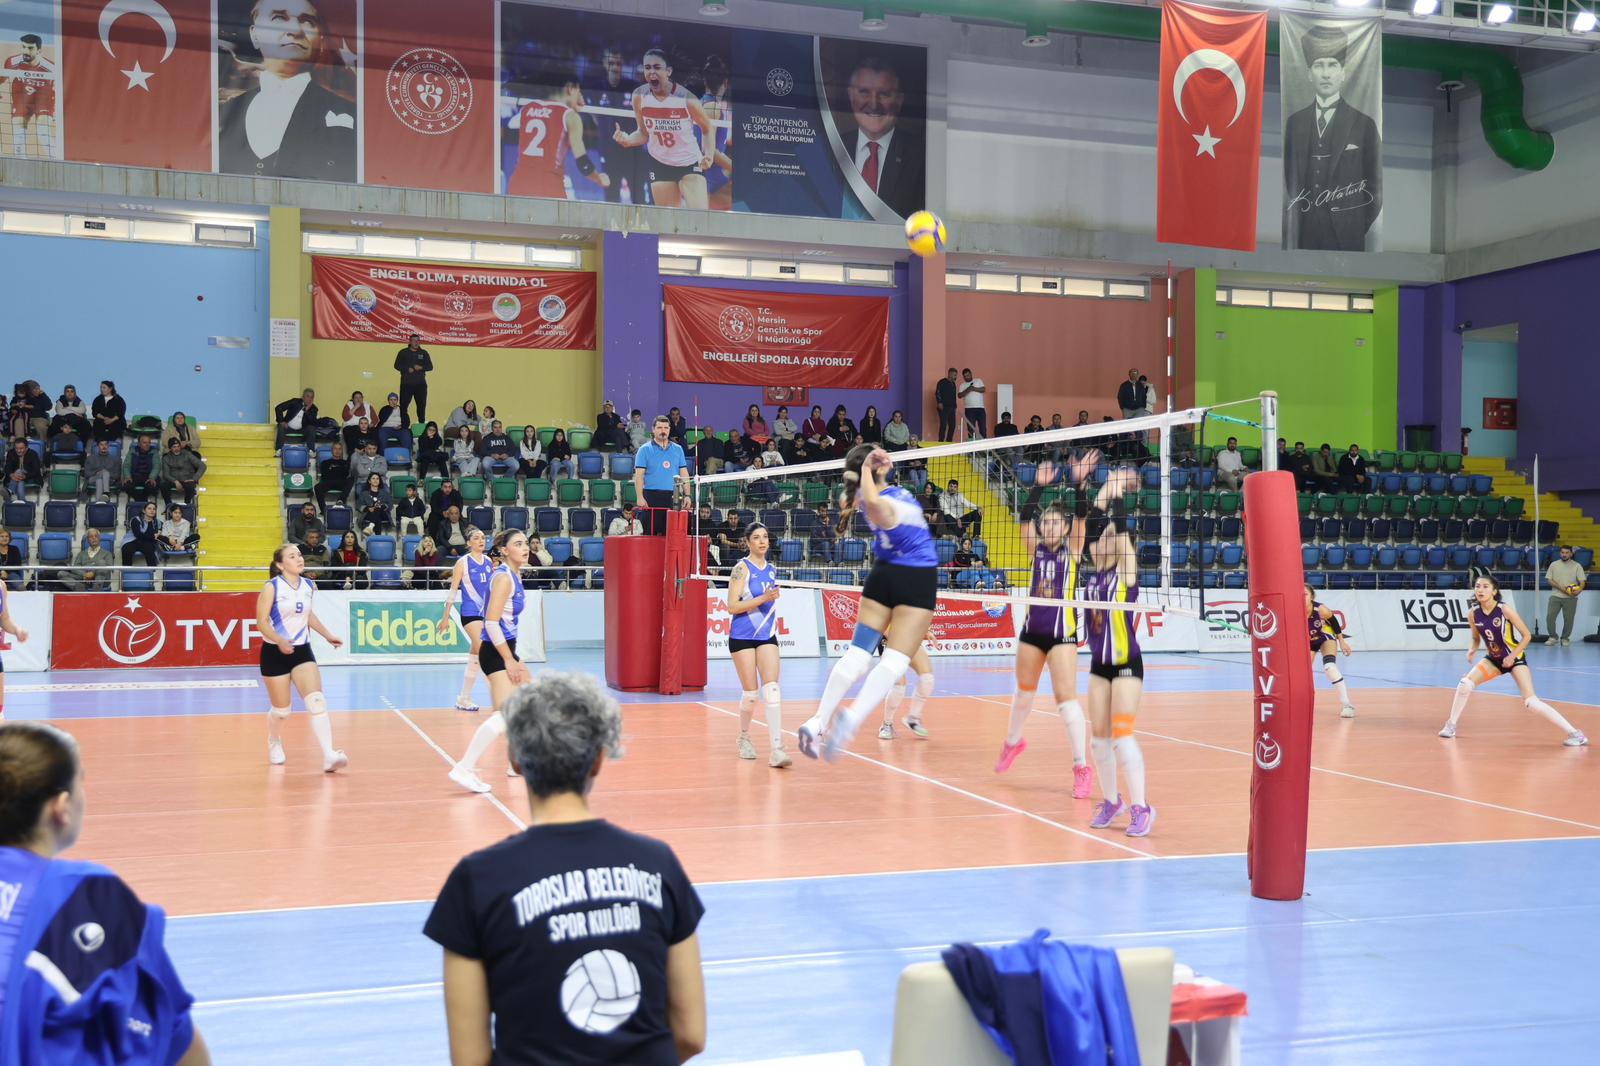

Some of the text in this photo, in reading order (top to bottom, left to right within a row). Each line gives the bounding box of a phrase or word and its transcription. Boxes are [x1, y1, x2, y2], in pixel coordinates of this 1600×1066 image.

[751, 115, 809, 128] TÜM ANTRENÖR
[742, 123, 816, 136] VE SPORCULARIMIZA
[522, 118, 546, 157] 2
[654, 131, 676, 148] 18
[745, 132, 779, 141] BAŞARILAR
[369, 268, 548, 288] ENGEL OLMA, FARKINDA OL
[757, 307, 772, 315] T.C.
[757, 316, 786, 324] Mersin
[757, 326, 789, 336] Gençlik
[803, 328, 823, 337] Spor
[765, 336, 811, 346] Müdürlüğü
[703, 351, 853, 368] ENGELLERİ SPORLA AŞIYORUZ
[295, 601, 304, 614] 9
[175, 618, 263, 651] TVF
[357, 609, 458, 647] iddaa
[1484, 629, 1495, 641] 9
[512, 863, 663, 927] TOROSLAR BELEDİYESİ
[549, 901, 642, 943] SPOR KULÜBÜ
